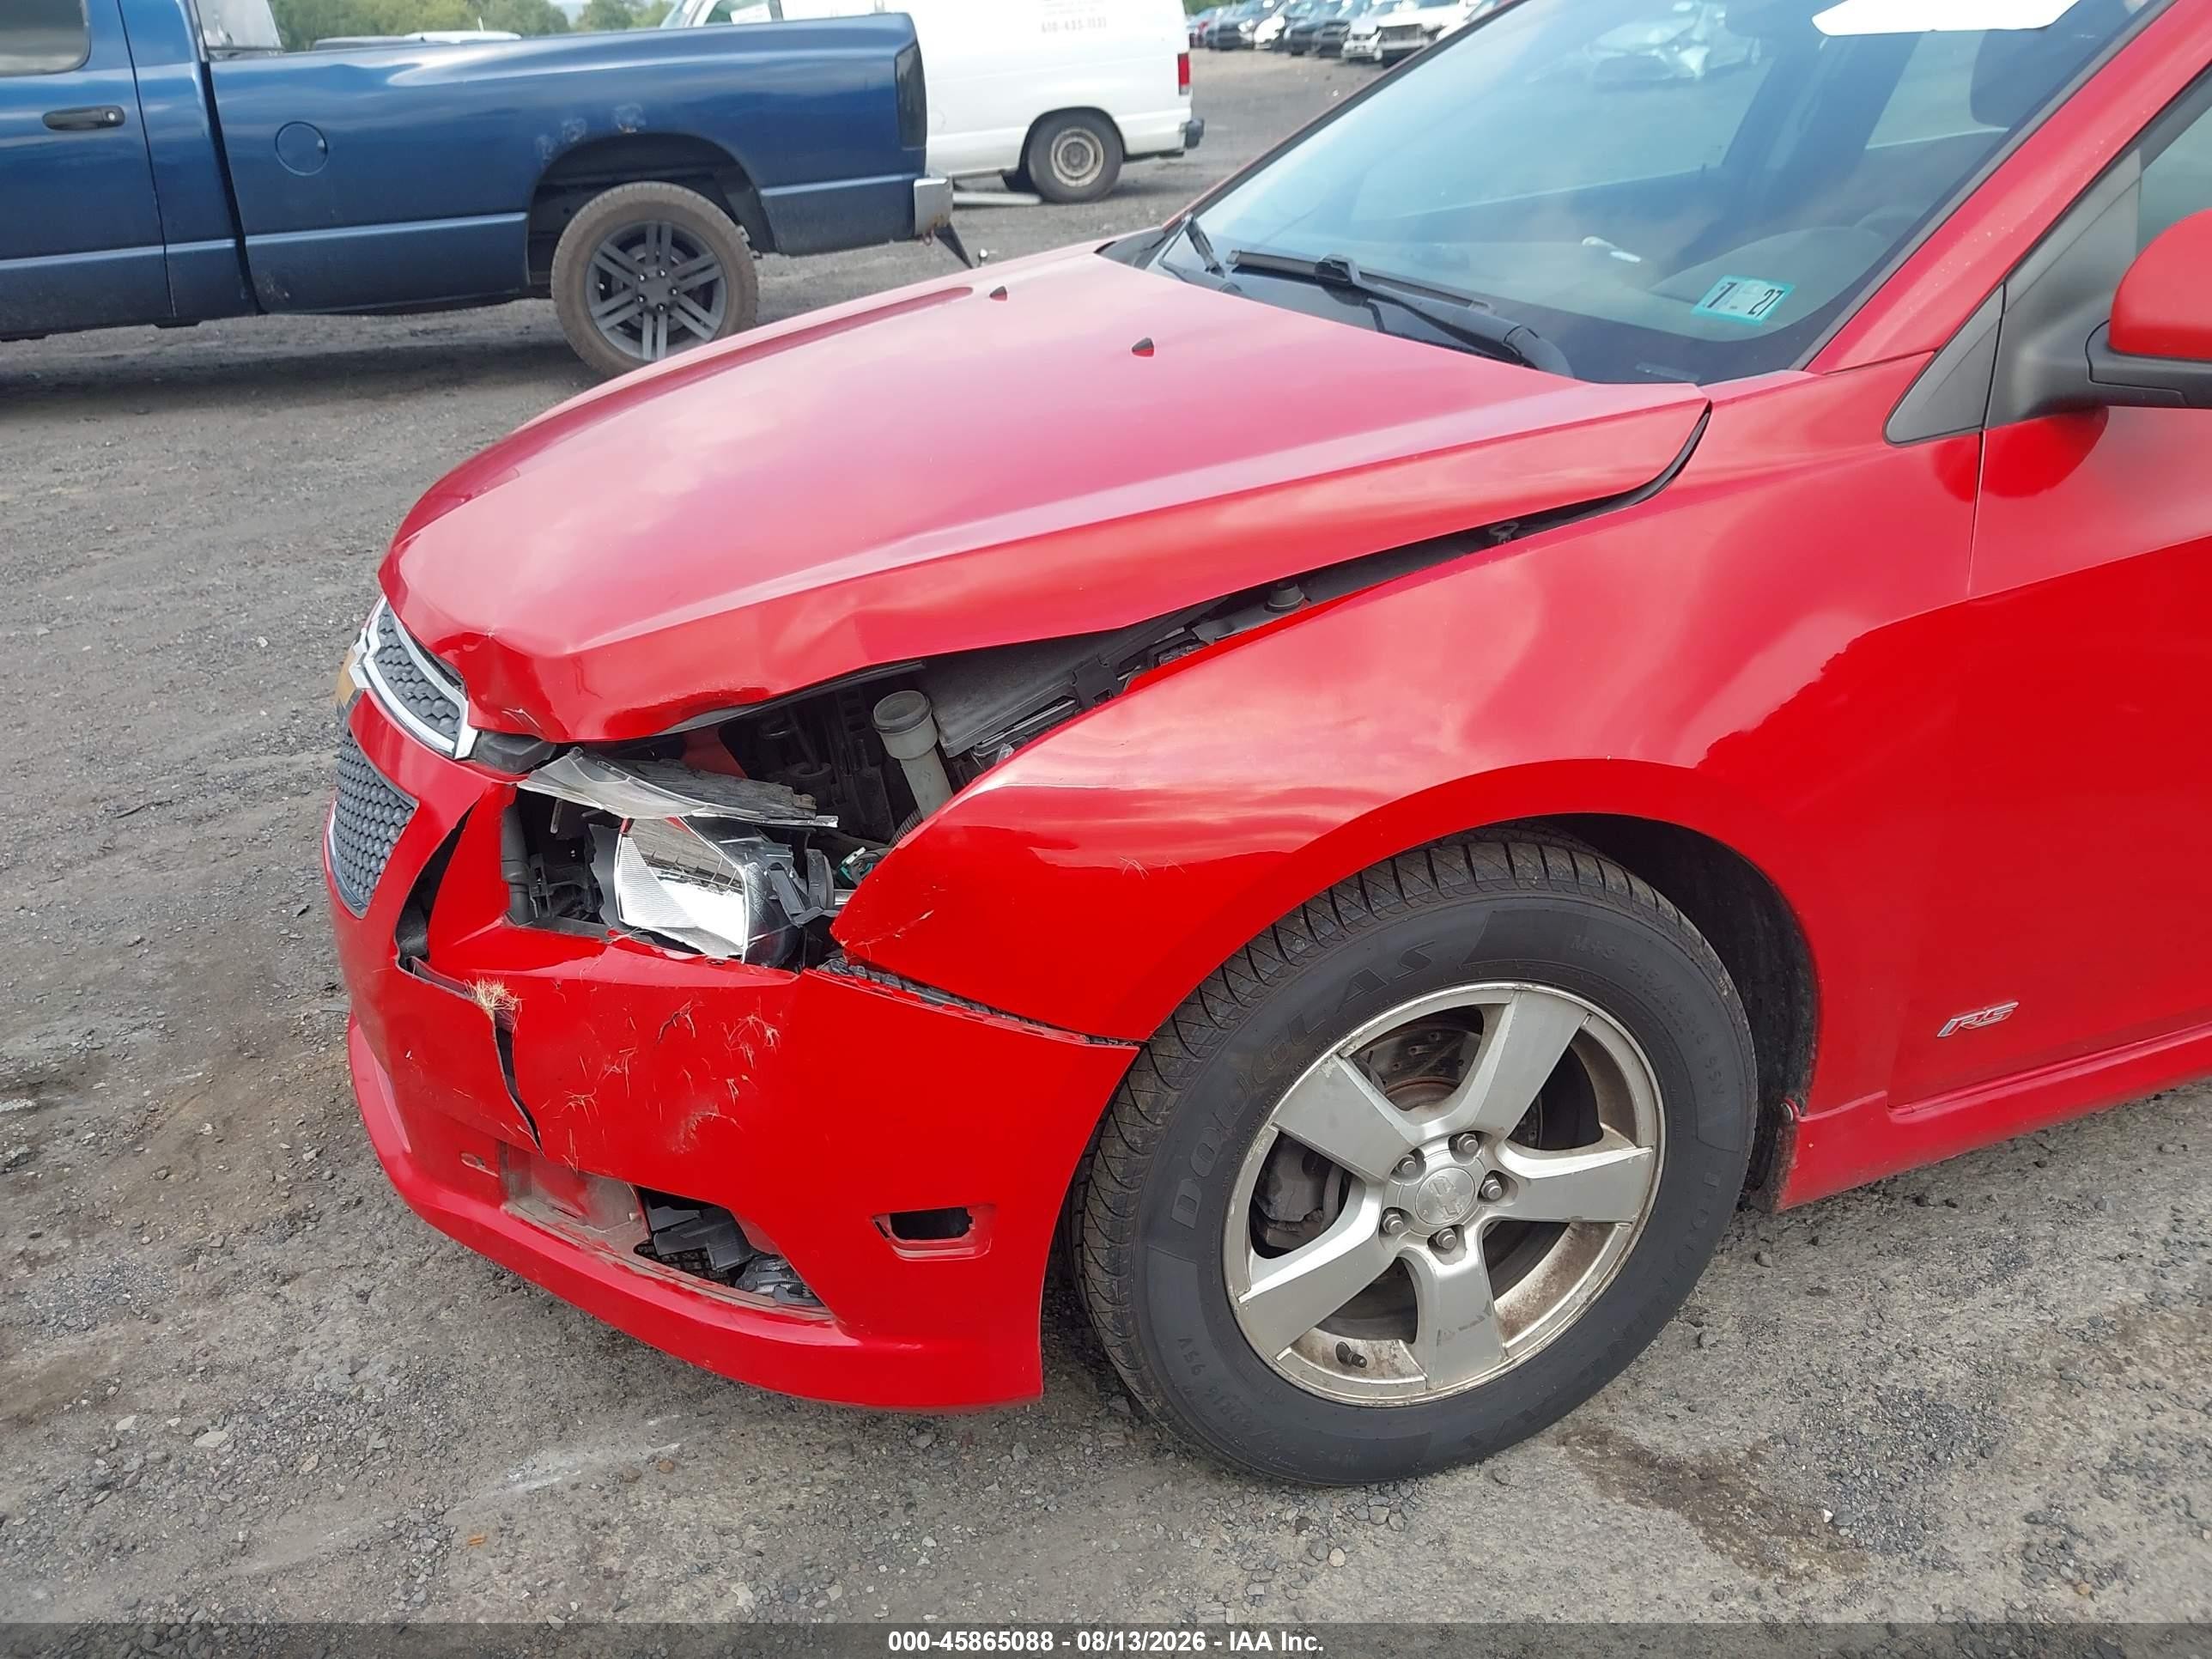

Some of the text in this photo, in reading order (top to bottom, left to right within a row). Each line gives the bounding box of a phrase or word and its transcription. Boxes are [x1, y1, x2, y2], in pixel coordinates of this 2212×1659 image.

[1706, 281, 1785, 317] 7 27
[1936, 1000, 2020, 1038] RS
[1170, 939, 1437, 1230] DOUGLAS
